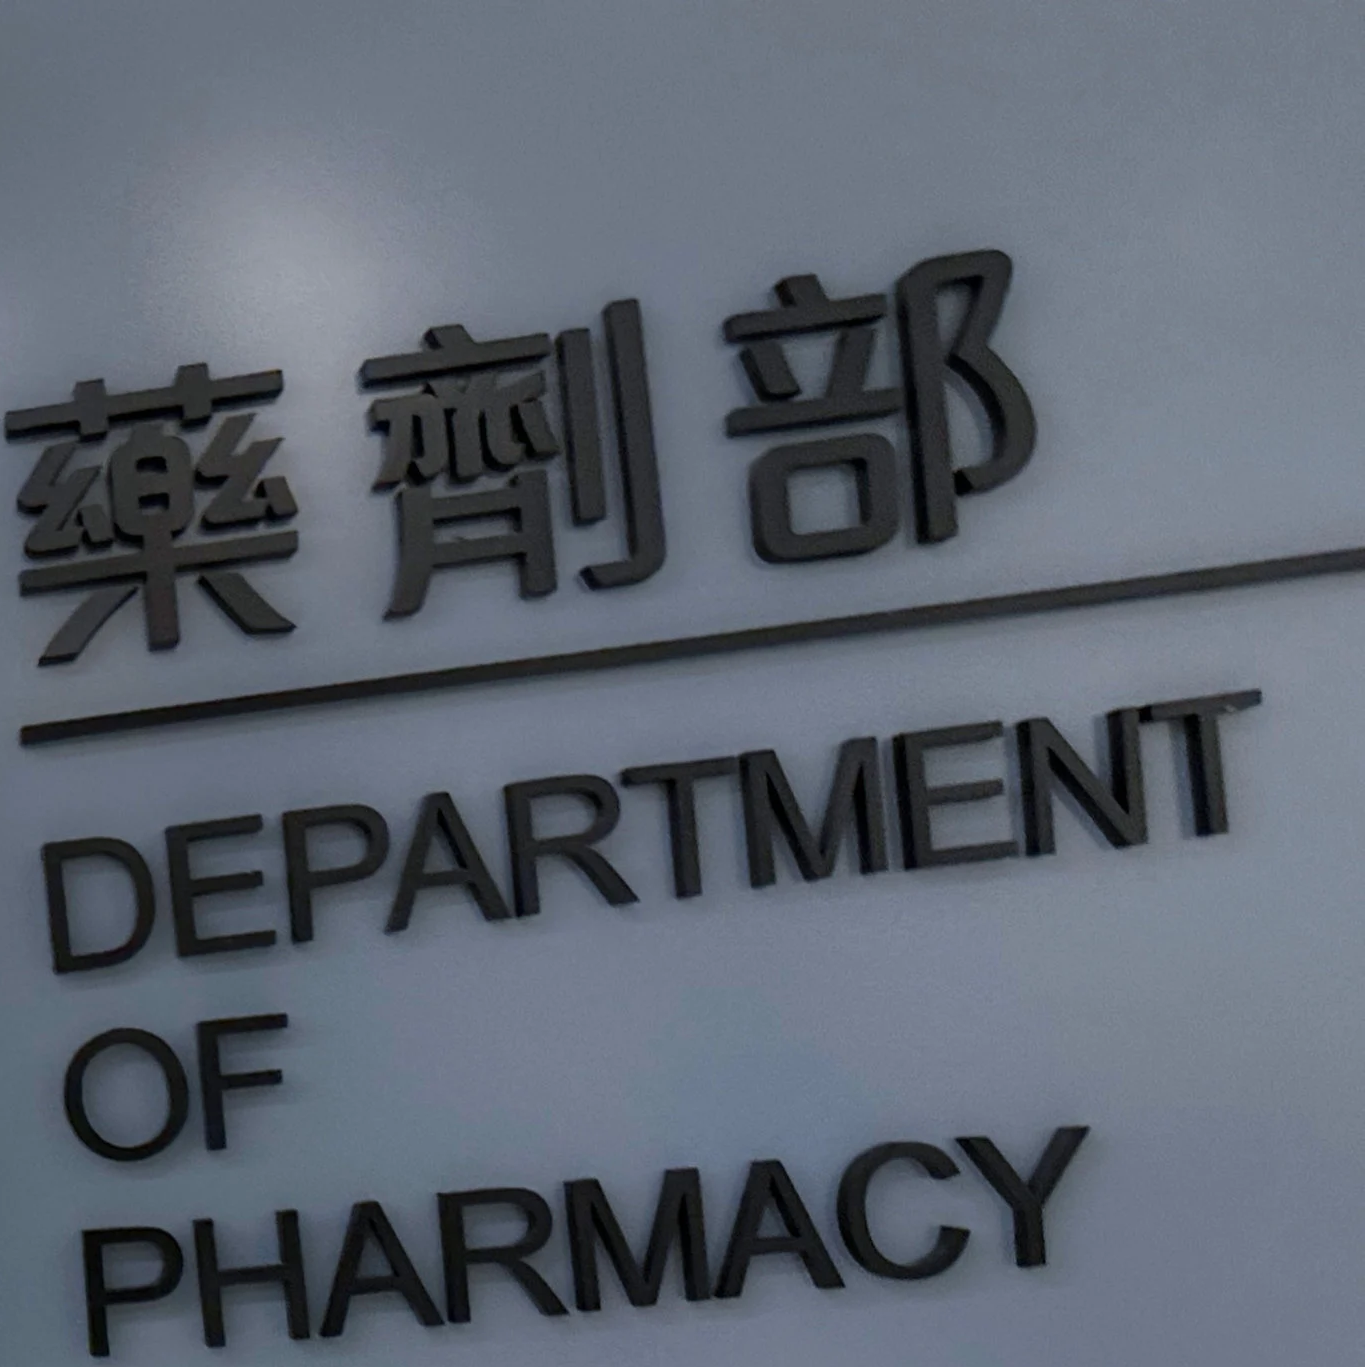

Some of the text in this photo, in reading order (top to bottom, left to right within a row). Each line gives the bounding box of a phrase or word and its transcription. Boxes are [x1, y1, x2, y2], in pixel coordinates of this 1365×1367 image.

[5, 247, 1038, 668] 藥劑部
[42, 688, 1263, 976] DEPARTMENT
[63, 1013, 288, 1163] OF
[81, 1125, 1090, 1360] PHARMACY
